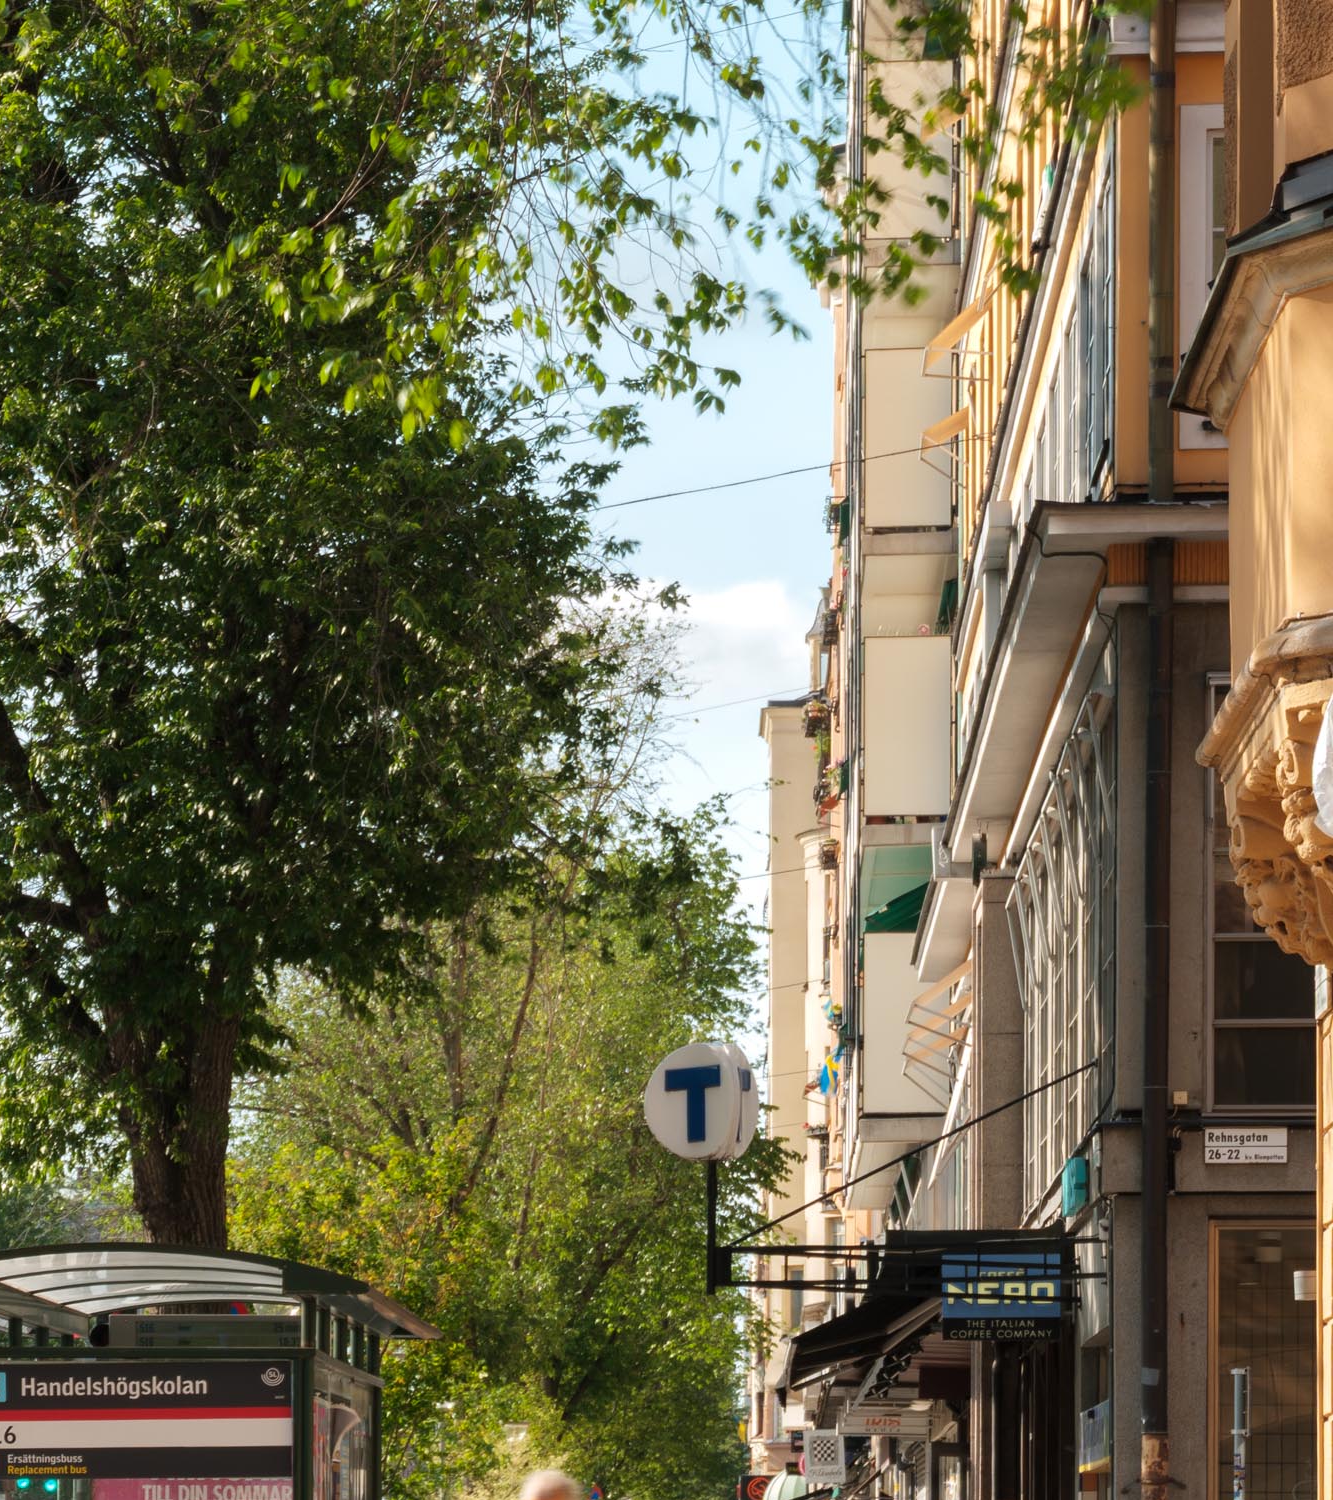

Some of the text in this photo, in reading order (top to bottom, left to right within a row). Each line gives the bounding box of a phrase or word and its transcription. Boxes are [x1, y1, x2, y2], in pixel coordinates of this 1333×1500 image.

[665, 1064, 720, 1143] T
[1208, 1132, 1268, 1145] Rehnsgatan
[1208, 1149, 1240, 1160] 26-22
[947, 1283, 1054, 1304] NERO
[967, 1320, 1035, 1328] THE ITALIAN
[950, 1329, 1053, 1339] COFFEE COMPANY
[20, 1375, 208, 1400] Handelshögskolan
[7, 1454, 83, 1465] Ersättningsbuss
[7, 1465, 87, 1476] Replacement bus
